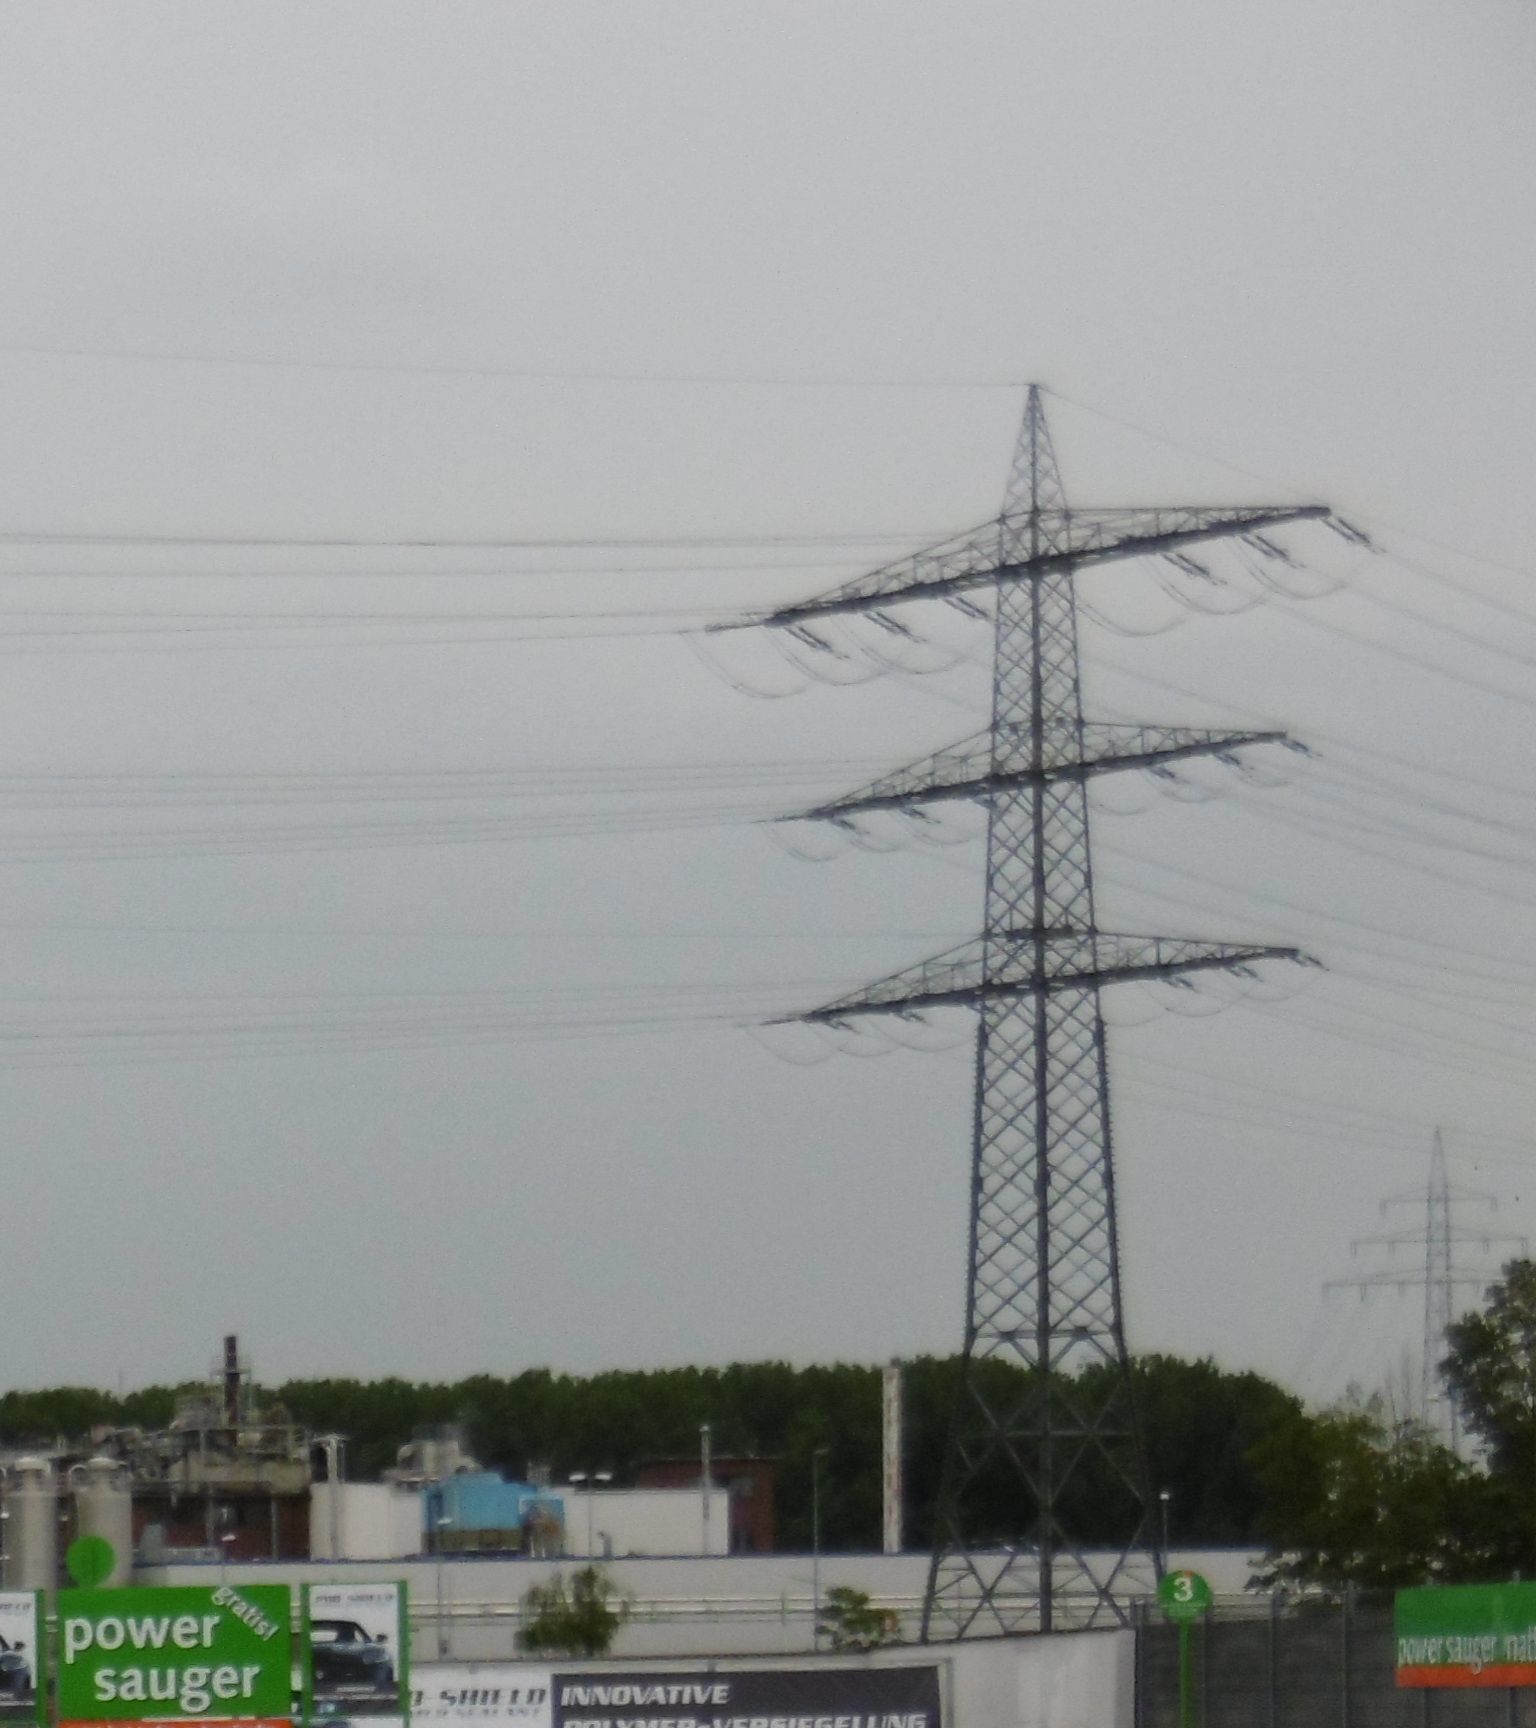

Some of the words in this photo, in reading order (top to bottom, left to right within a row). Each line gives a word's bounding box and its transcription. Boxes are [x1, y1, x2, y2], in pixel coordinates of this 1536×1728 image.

[210, 1585, 281, 1643] gratis!
[1174, 1577, 1194, 1602] 3
[63, 1614, 221, 1665] power
[93, 1665, 261, 1714] sauger
[561, 1685, 730, 1706] INNOVATIVE
